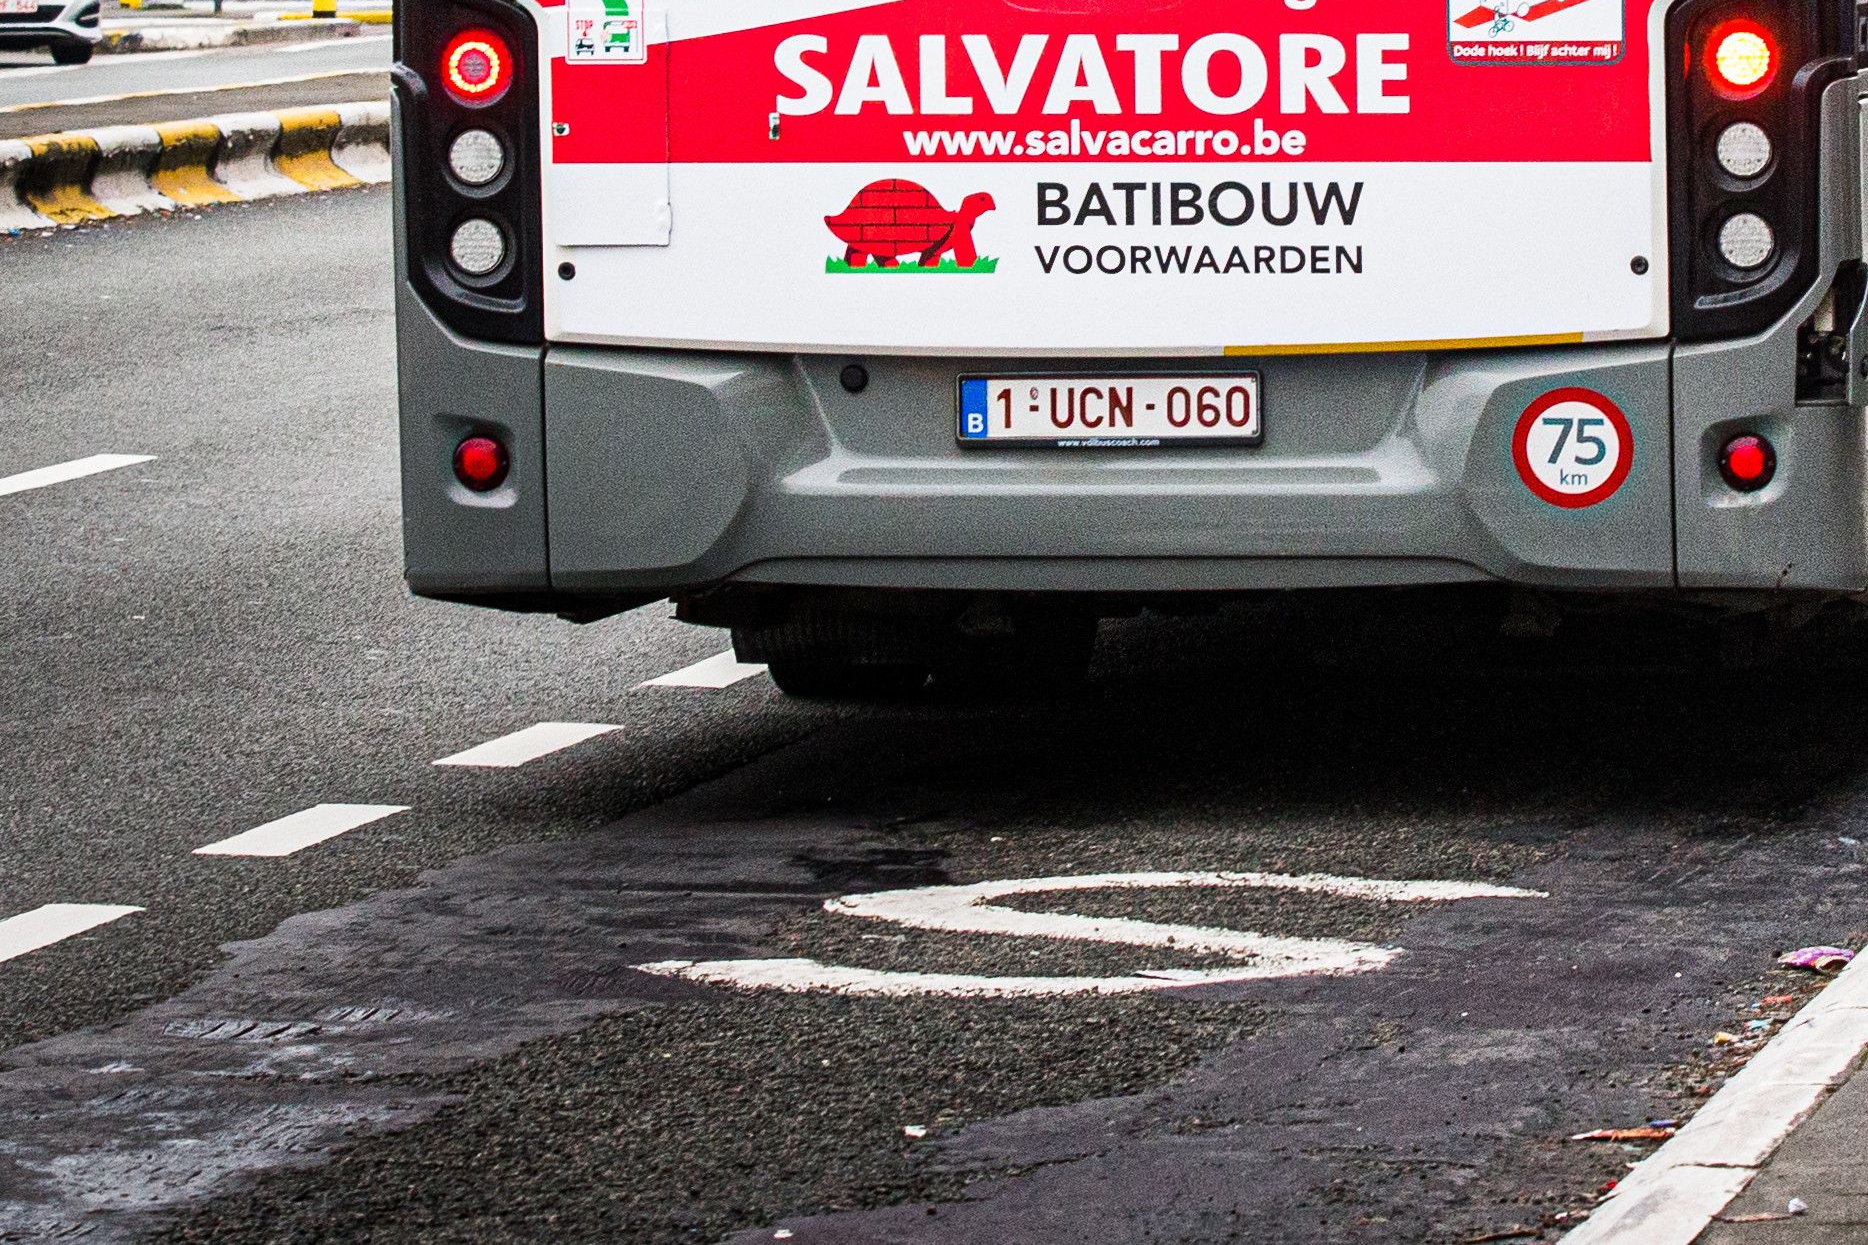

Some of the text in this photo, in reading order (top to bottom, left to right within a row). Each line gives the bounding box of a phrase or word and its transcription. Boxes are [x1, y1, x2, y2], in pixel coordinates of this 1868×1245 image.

[1453, 44, 1486, 57] Dode
[1526, 44, 1550, 60] Blijf
[1550, 44, 1591, 57] achter
[773, 32, 1411, 116] SALVATORE
[902, 119, 1307, 157] www.salvacarro.be
[1037, 180, 1364, 227] BATIBOUW
[1034, 244, 1364, 275] VOORWAARDEN
[967, 412, 984, 433] B
[1541, 418, 1607, 466] 75
[1558, 468, 1589, 488] km
